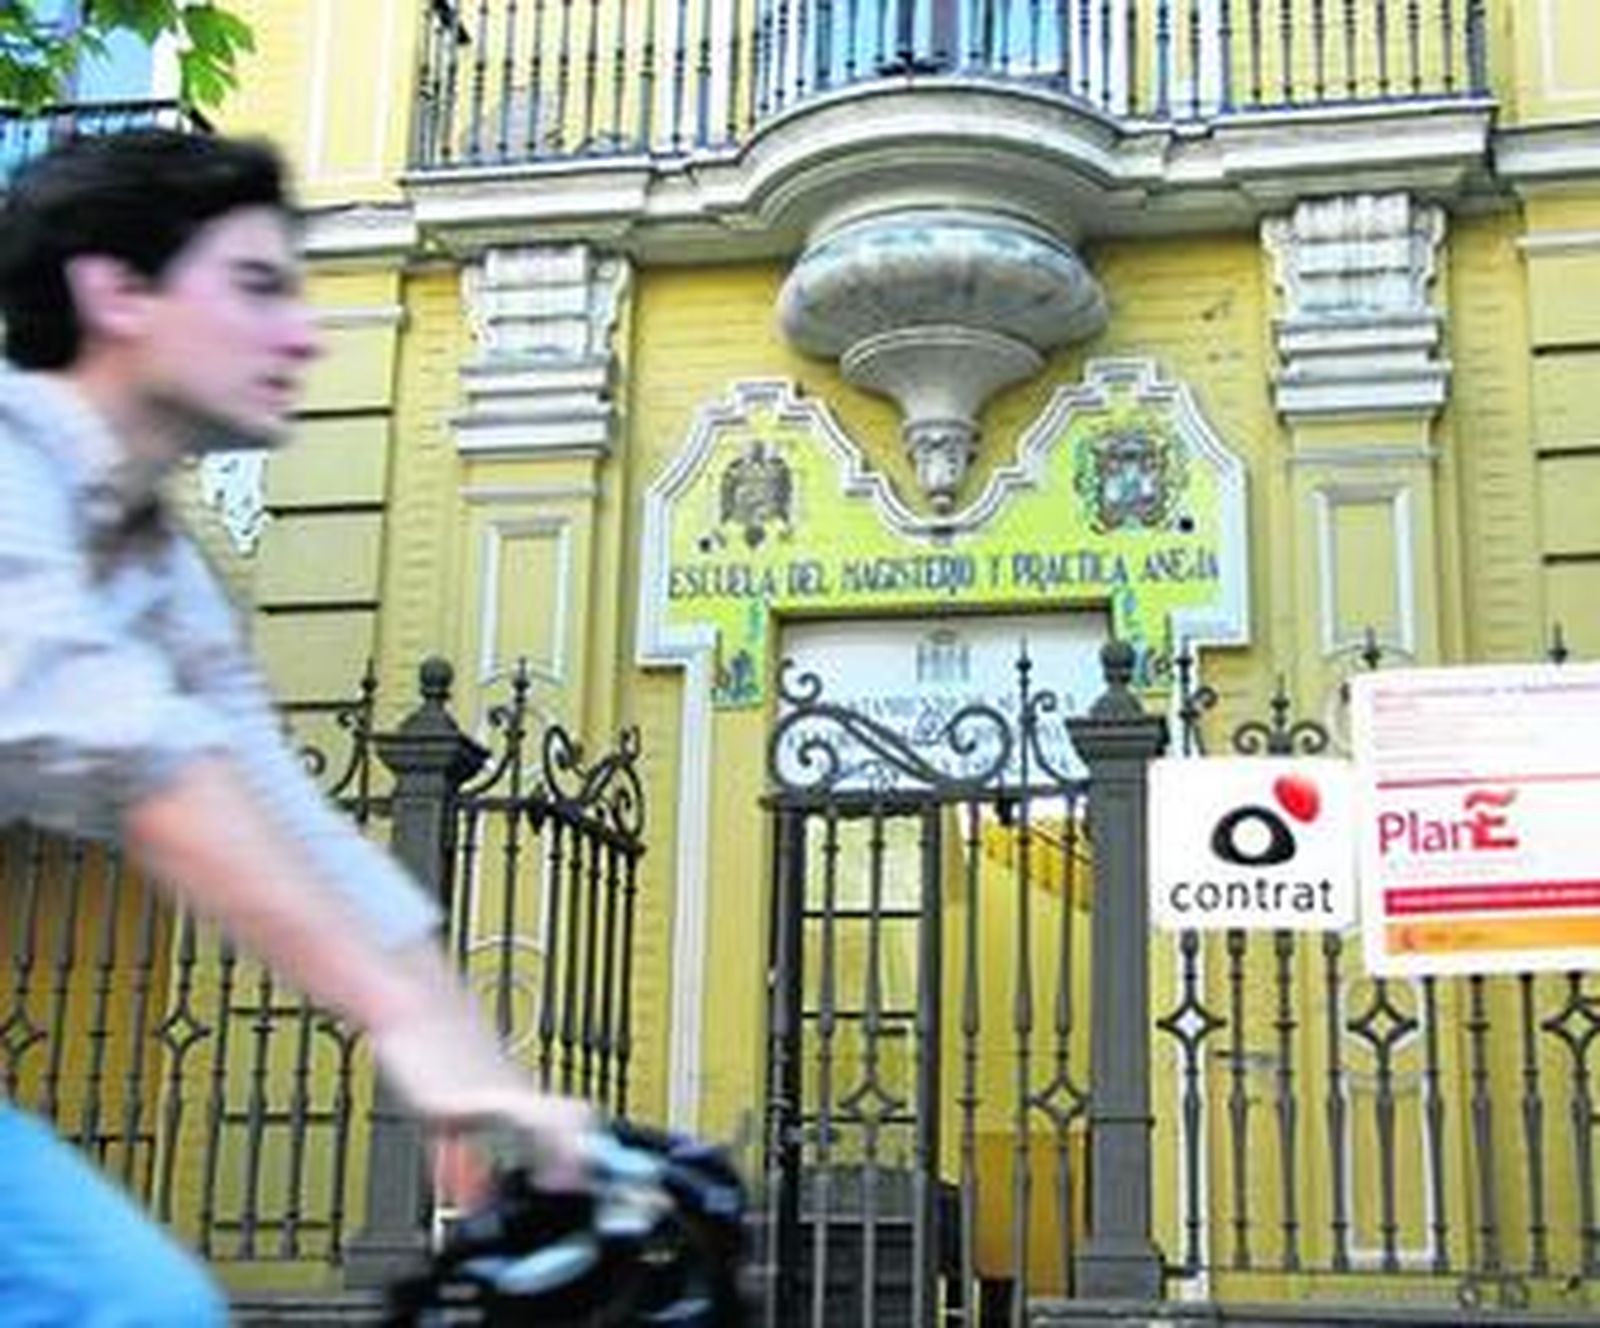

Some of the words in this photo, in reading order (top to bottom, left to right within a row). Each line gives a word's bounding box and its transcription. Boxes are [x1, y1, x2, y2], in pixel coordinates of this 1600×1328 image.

[668, 564, 776, 599] ESCUELA
[787, 561, 829, 595] DEL
[842, 554, 976, 595] MAGISTERIO
[1141, 546, 1220, 583] ANEJA
[1168, 878, 1335, 914] contrat
